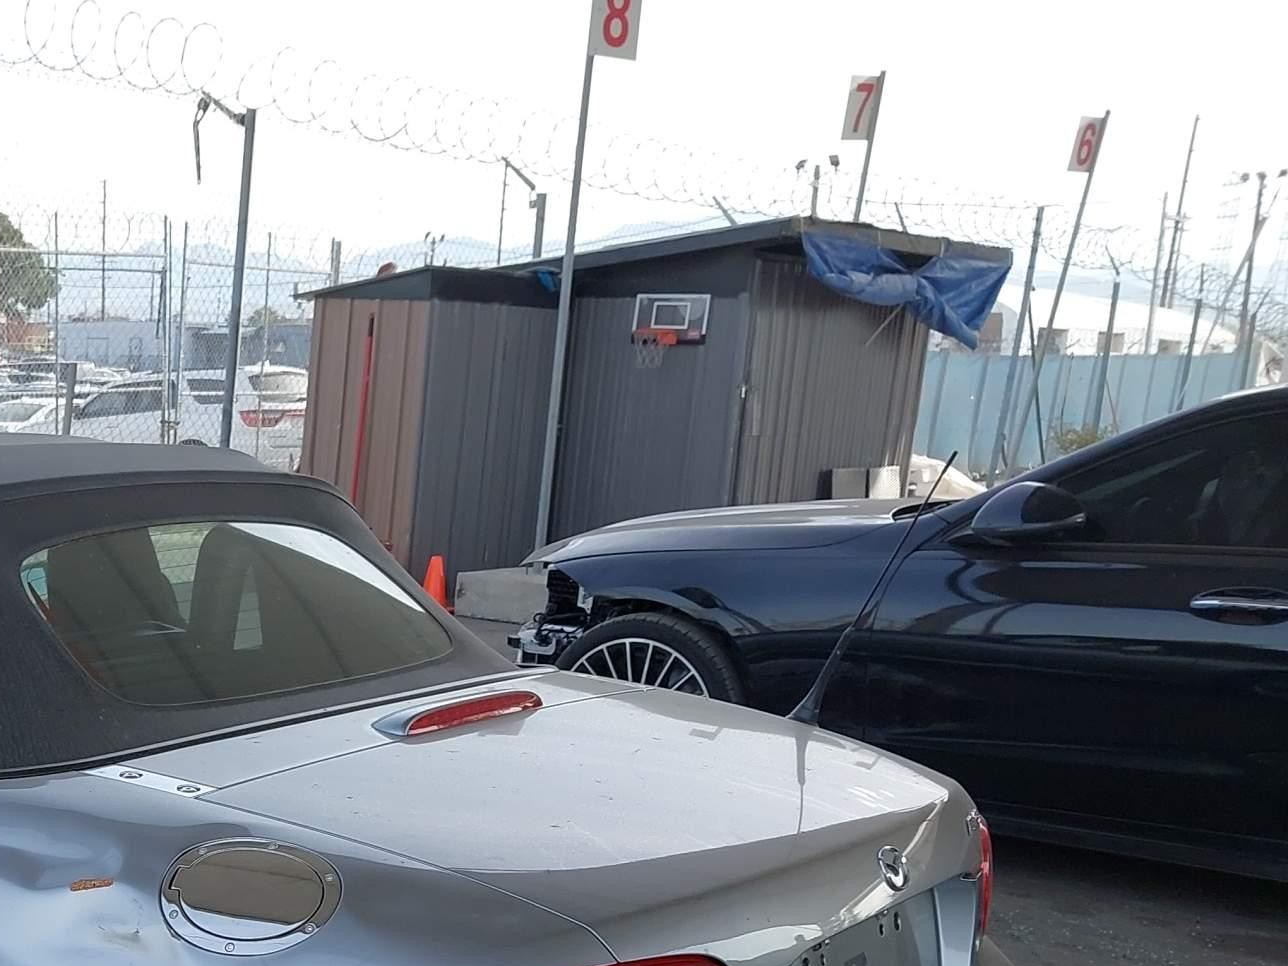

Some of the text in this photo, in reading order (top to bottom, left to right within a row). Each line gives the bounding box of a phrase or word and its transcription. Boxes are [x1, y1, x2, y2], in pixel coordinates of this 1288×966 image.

[602, 0, 631, 48] 8
[853, 83, 875, 133] 7
[1077, 123, 1097, 167] 6
